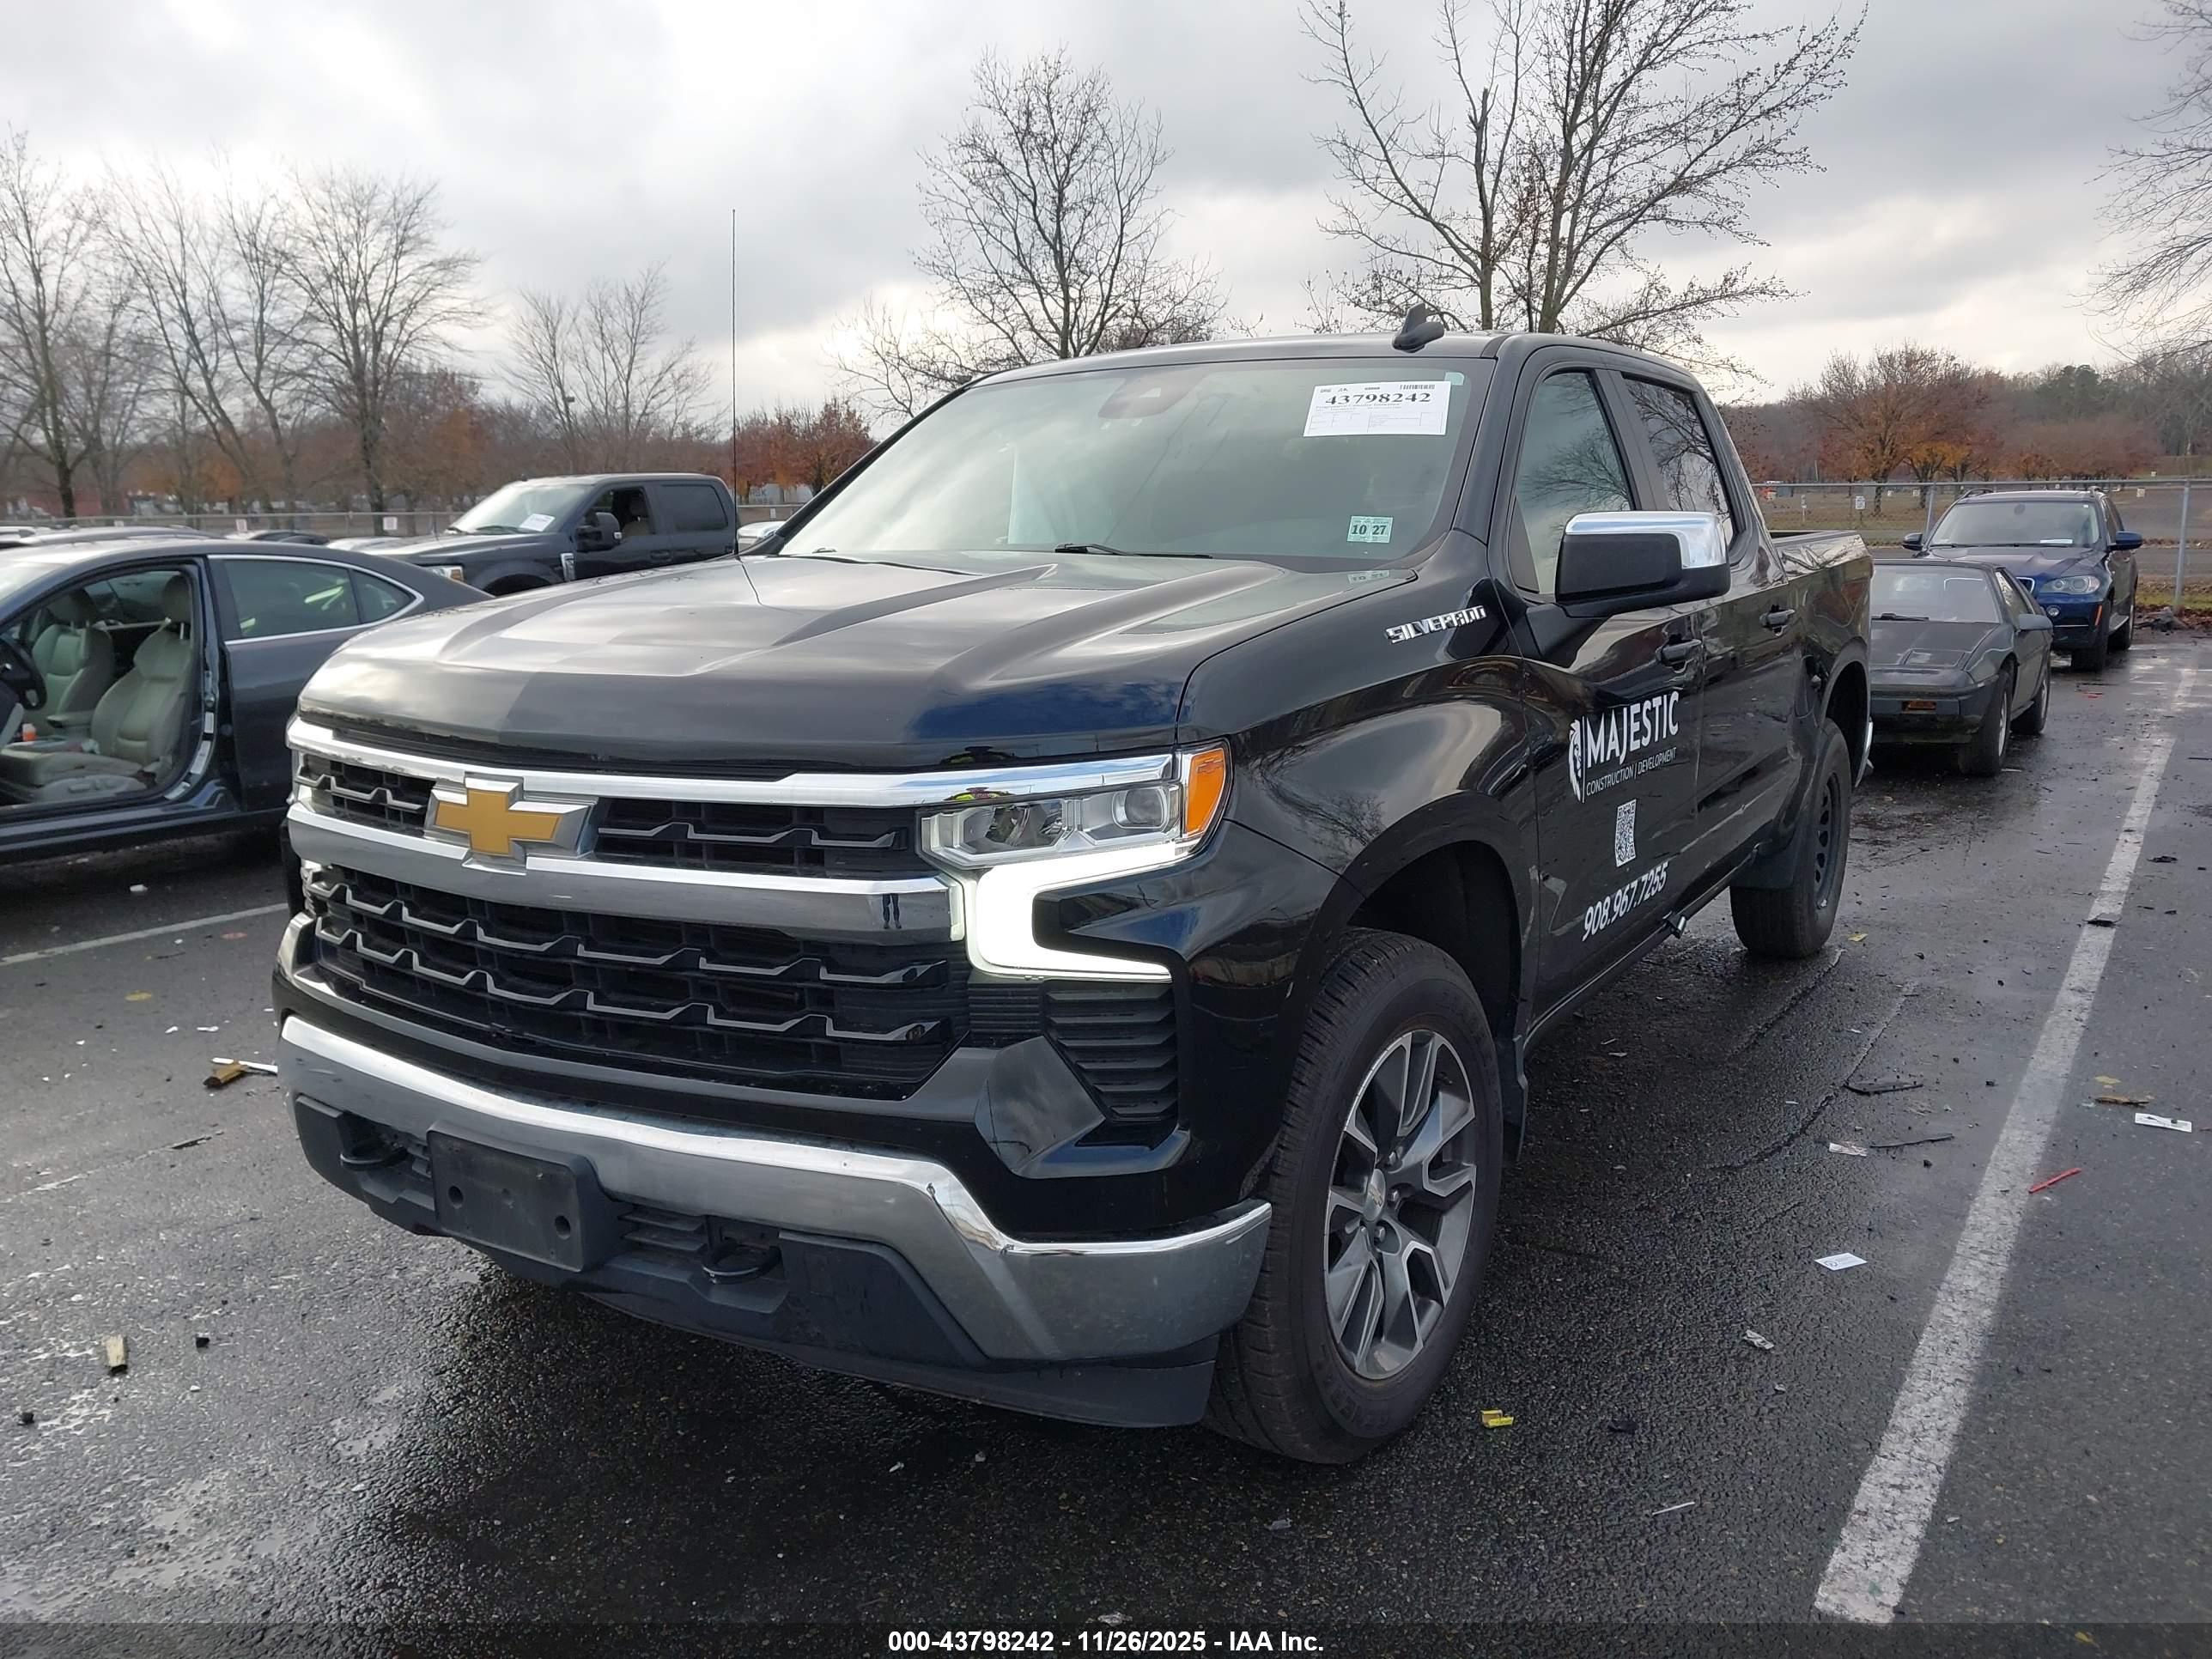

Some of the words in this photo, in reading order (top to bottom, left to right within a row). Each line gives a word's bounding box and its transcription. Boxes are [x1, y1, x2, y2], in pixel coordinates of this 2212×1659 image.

[1326, 392, 1431, 405] 43798242
[1352, 525, 1367, 535] 10
[1372, 525, 1387, 536] 27
[1586, 690, 1680, 769] MAJESTIC
[1586, 765, 1633, 797] CONSTRUCTION
[1638, 747, 1677, 775] DEVELOPMENT
[1582, 860, 1668, 942] 908.967.7255
